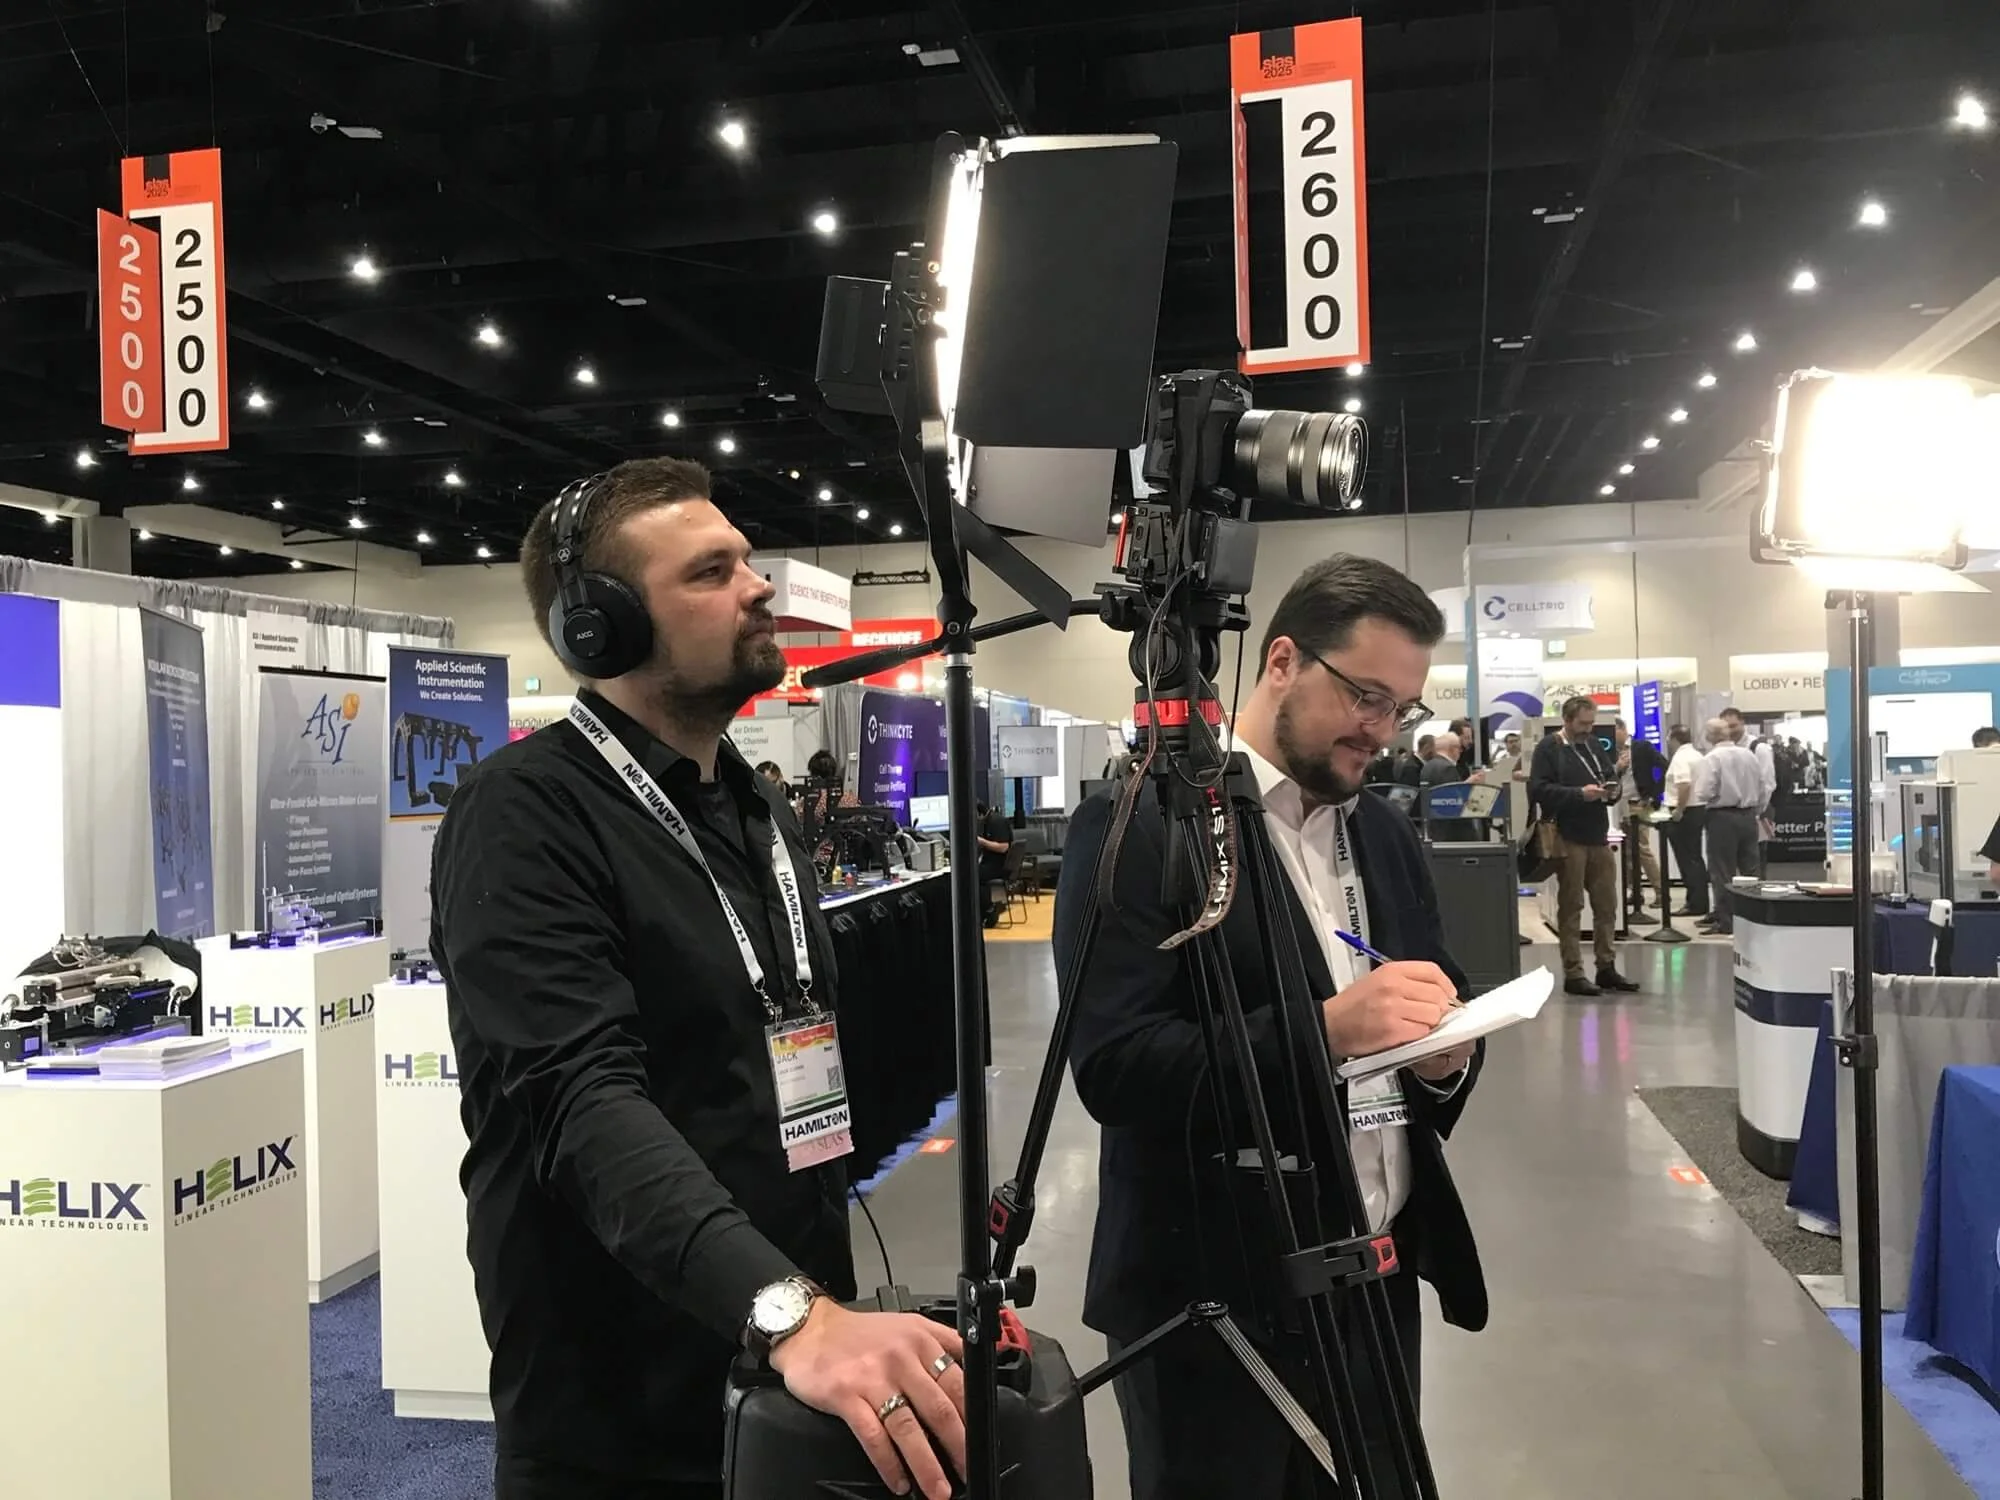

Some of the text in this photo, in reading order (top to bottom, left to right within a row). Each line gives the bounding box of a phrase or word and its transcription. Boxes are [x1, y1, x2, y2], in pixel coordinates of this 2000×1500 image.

[1262, 56, 1294, 70] slas
[1263, 66, 1292, 79] 2025
[1300, 111, 1341, 341] 2600
[119, 234, 145, 419] 2500
[175, 228, 207, 428] 2500
[576, 629, 594, 641] AKG
[415, 659, 487, 675] Applied Scientific
[417, 674, 485, 689] Instrumentation
[1435, 688, 1468, 700] LOBB
[1743, 677, 1790, 690] LOBBY
[420, 690, 430, 700] We
[430, 691, 452, 701] Create
[301, 693, 352, 765] ASI
[571, 704, 609, 744] HAMILT
[879, 723, 913, 739] THINKCYTE
[621, 762, 686, 837] HAMILTON
[1206, 786, 1225, 836] S1H
[1207, 841, 1229, 918] LUMIX
[779, 870, 805, 949] HAMILTON
[210, 1004, 305, 1028] HELIX
[385, 1051, 459, 1079] HEL
[776, 1051, 798, 1065] JACK
[785, 1110, 848, 1141] HAMILTON
[1352, 1107, 1410, 1128] HAMILTON
[174, 1135, 297, 1216] HELIX
[174, 1171, 298, 1227] LINEAR TECHNOLOGIES
[0, 1219, 149, 1231] NEAR TECHNOLOGIES
